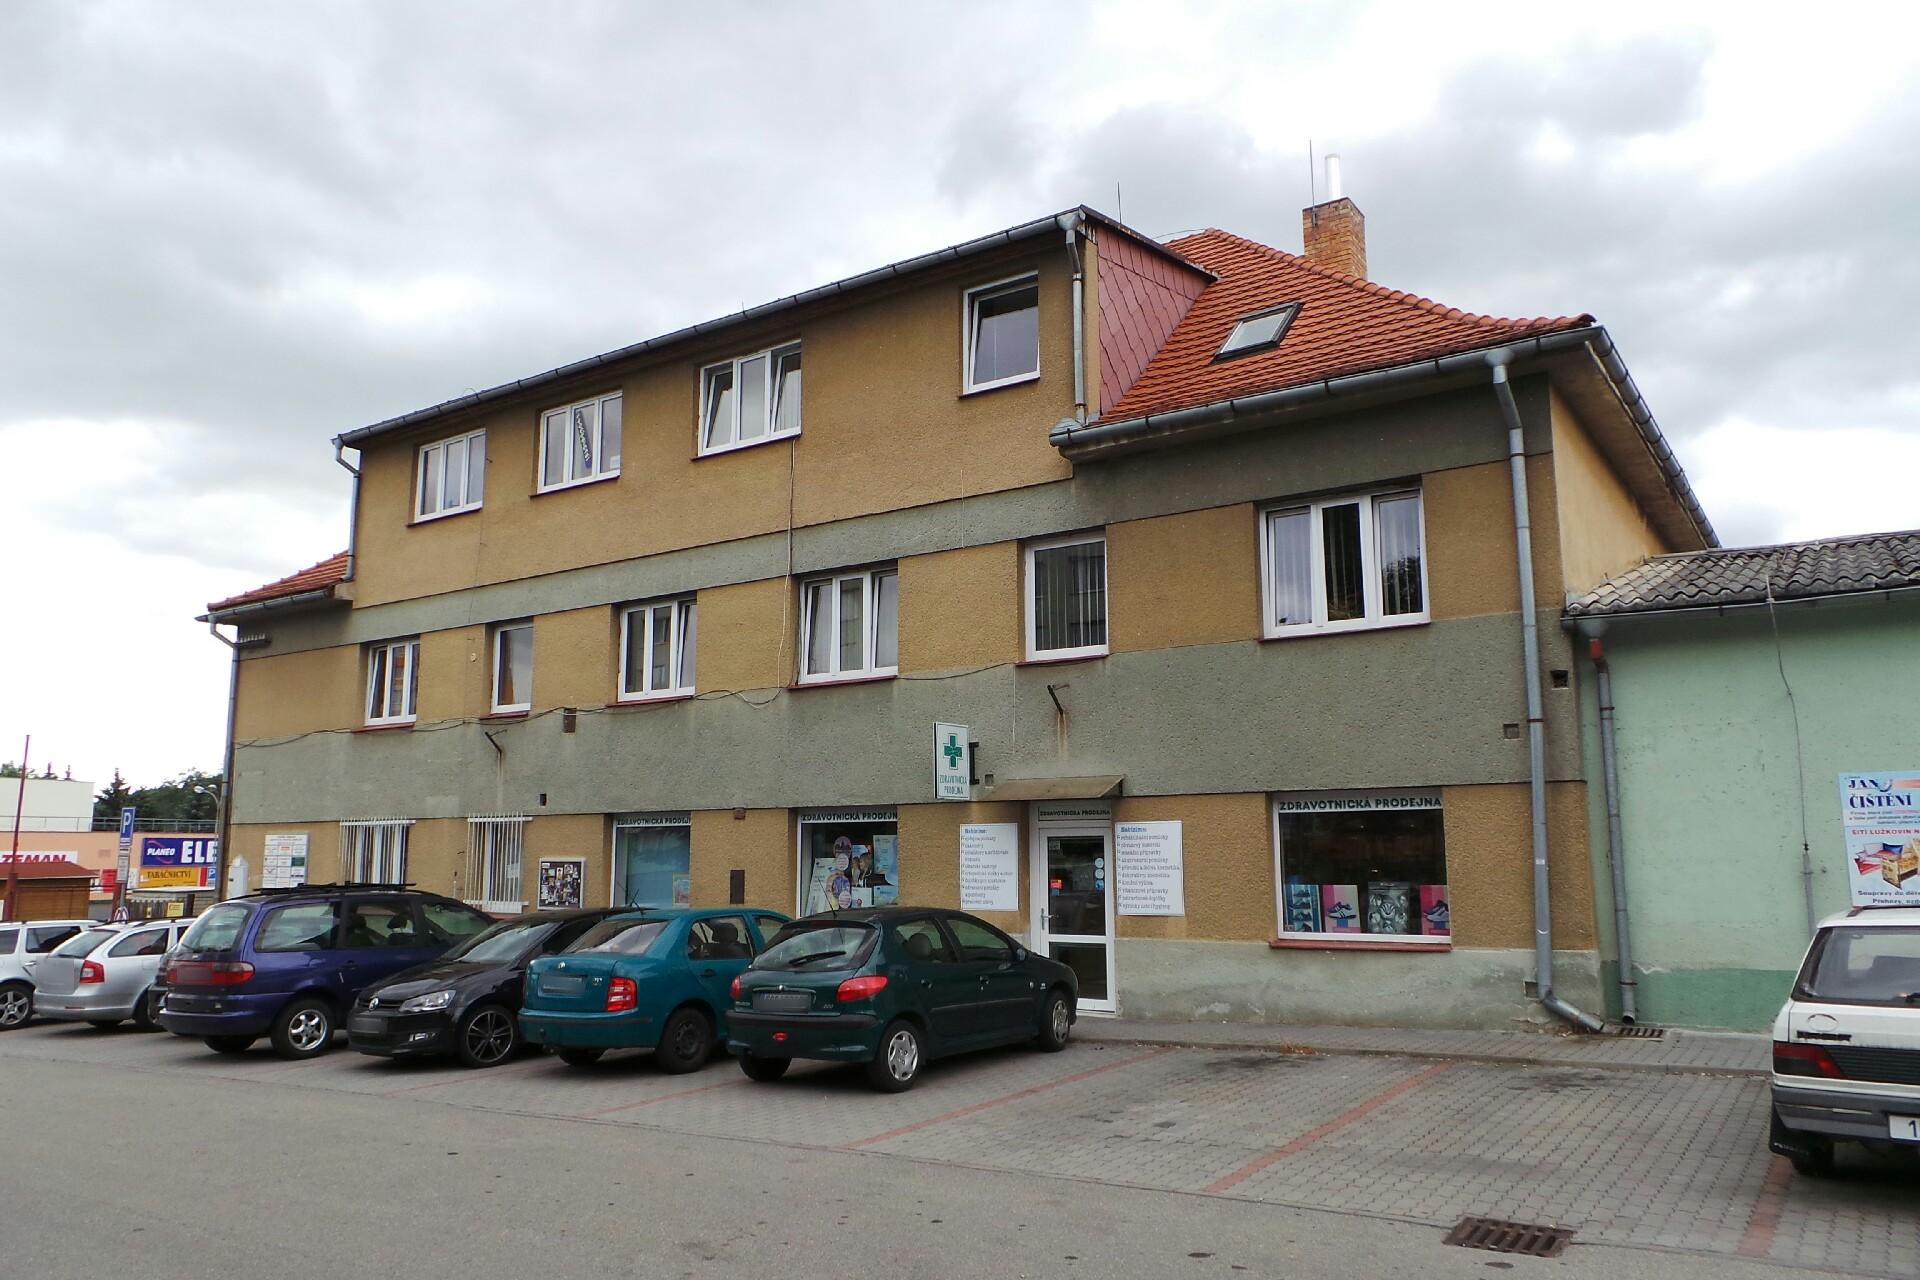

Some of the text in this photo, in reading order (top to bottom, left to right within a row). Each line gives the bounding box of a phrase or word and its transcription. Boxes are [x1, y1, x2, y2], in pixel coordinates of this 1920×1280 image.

[1279, 797, 1442, 811] ZDRAVOTNICKÁ PRODEJNA
[1849, 793, 1912, 809] ČIŠTĚNÍ
[123, 812, 131, 834] P
[146, 847, 176, 856] PLANEO
